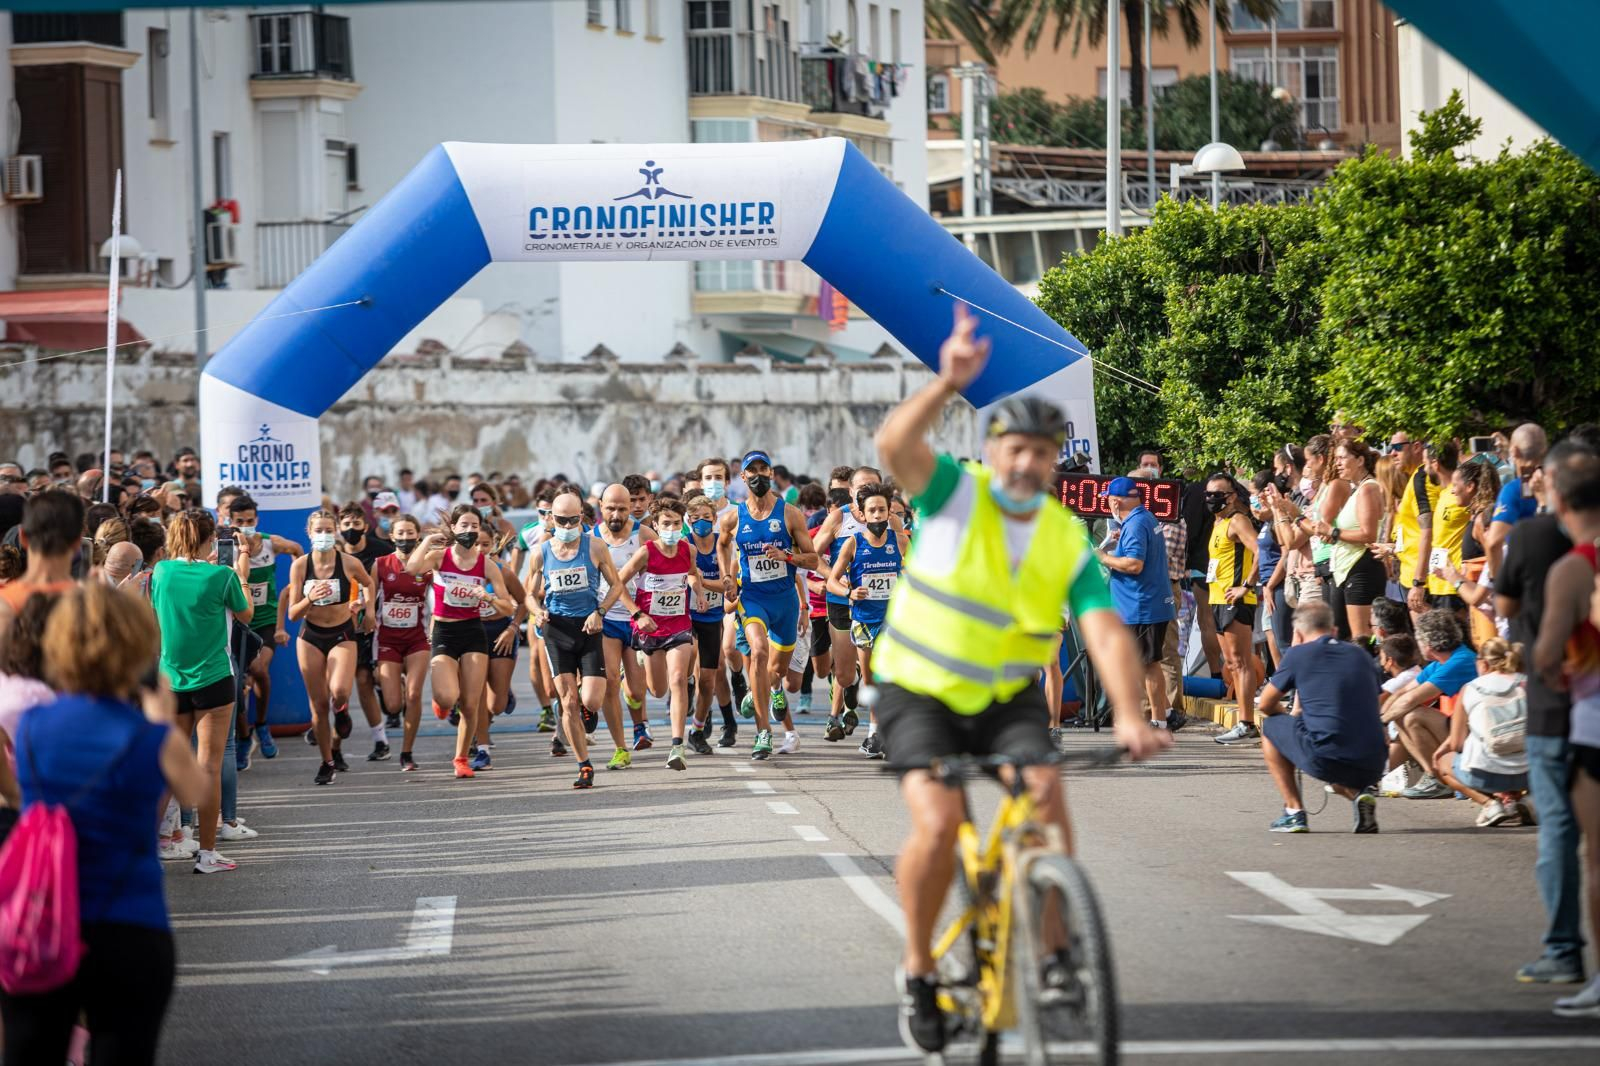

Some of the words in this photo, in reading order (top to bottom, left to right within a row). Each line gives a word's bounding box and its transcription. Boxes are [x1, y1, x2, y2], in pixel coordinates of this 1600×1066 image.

[529, 202, 775, 239] CRONOFINISHER
[524, 242, 612, 251] CRONOMETRAJE
[626, 239, 707, 249] ORGANIZACIÓN
[709, 240, 724, 248] DE
[727, 238, 777, 248] EVENTOS
[238, 443, 294, 463] CRONO
[219, 461, 311, 489] FINISHER
[755, 559, 780, 571] 406
[556, 573, 581, 587] 182
[868, 578, 891, 590] 421
[450, 586, 474, 599] 464
[657, 595, 681, 607] 422
[388, 607, 412, 619] 466
